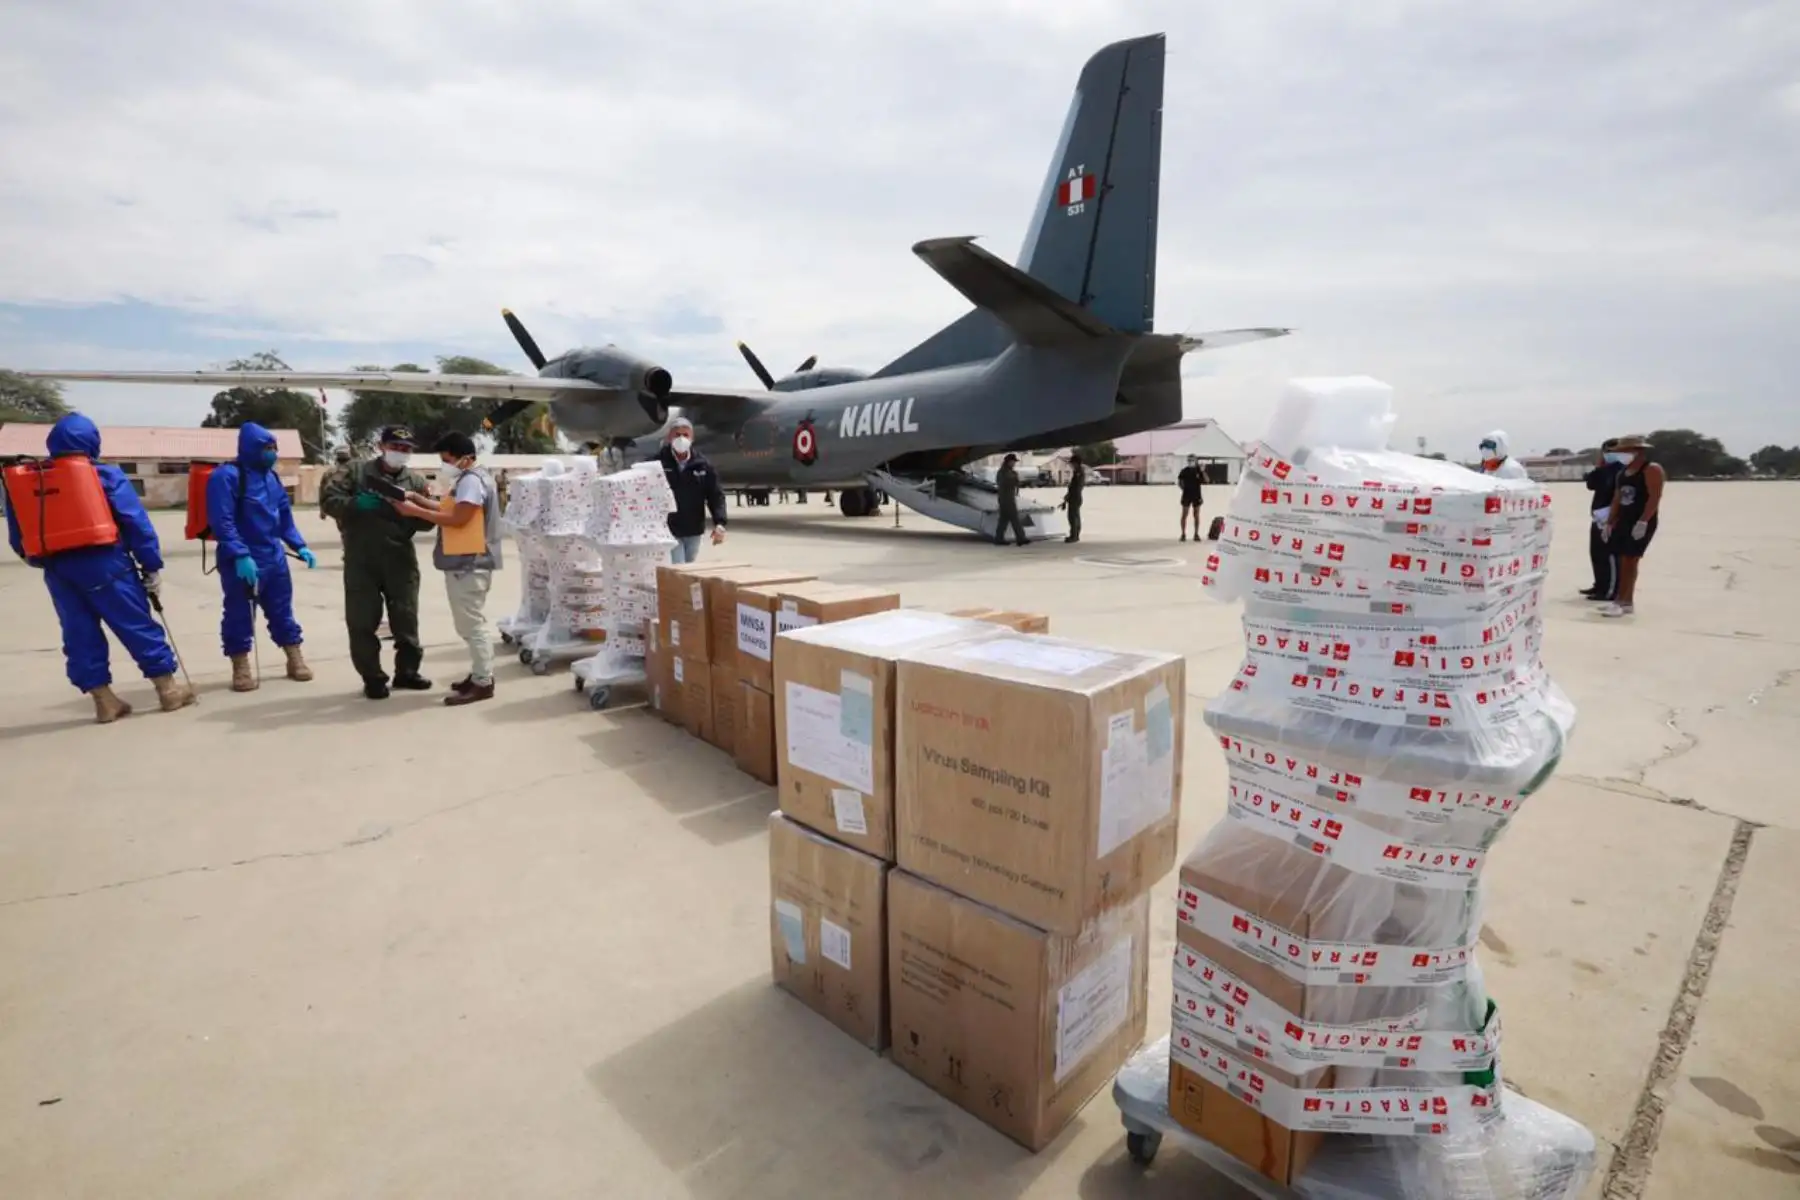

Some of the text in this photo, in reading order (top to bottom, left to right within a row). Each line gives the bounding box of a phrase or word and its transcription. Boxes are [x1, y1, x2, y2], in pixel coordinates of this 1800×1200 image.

[1067, 202, 1085, 217] 531
[839, 397, 919, 438] NAVAL
[923, 746, 1051, 798] Virus Sampling Kit
[1232, 740, 1339, 785] FRAGIL
[1230, 785, 1322, 830] FRAGIL
[1252, 926, 1360, 964] FRAGIL
[1307, 1031, 1404, 1049] FRAGIL
[1326, 1099, 1428, 1114] FRAGIL
